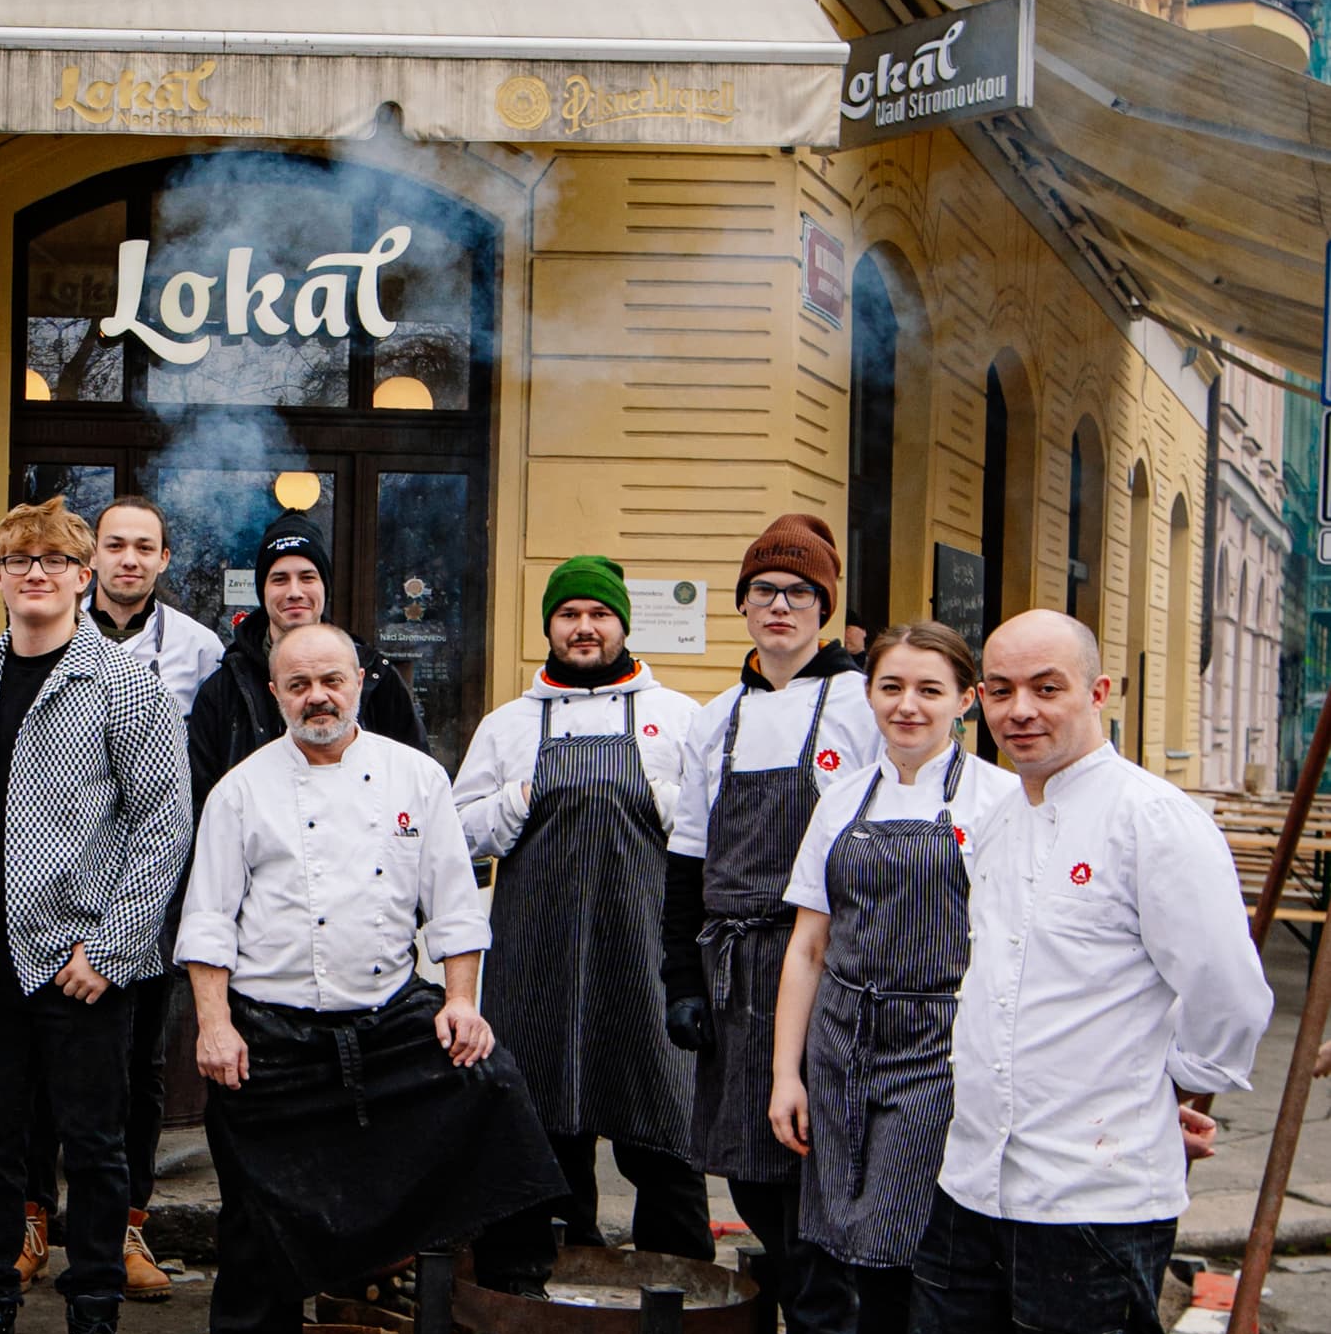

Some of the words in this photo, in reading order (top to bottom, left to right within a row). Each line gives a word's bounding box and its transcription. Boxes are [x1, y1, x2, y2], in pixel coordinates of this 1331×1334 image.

[119, 111, 154, 127] Nad
[562, 75, 652, 135] Pilsner
[649, 73, 735, 124] Urquell
[875, 97, 906, 127] Nad
[908, 75, 1008, 119] Stromovkou
